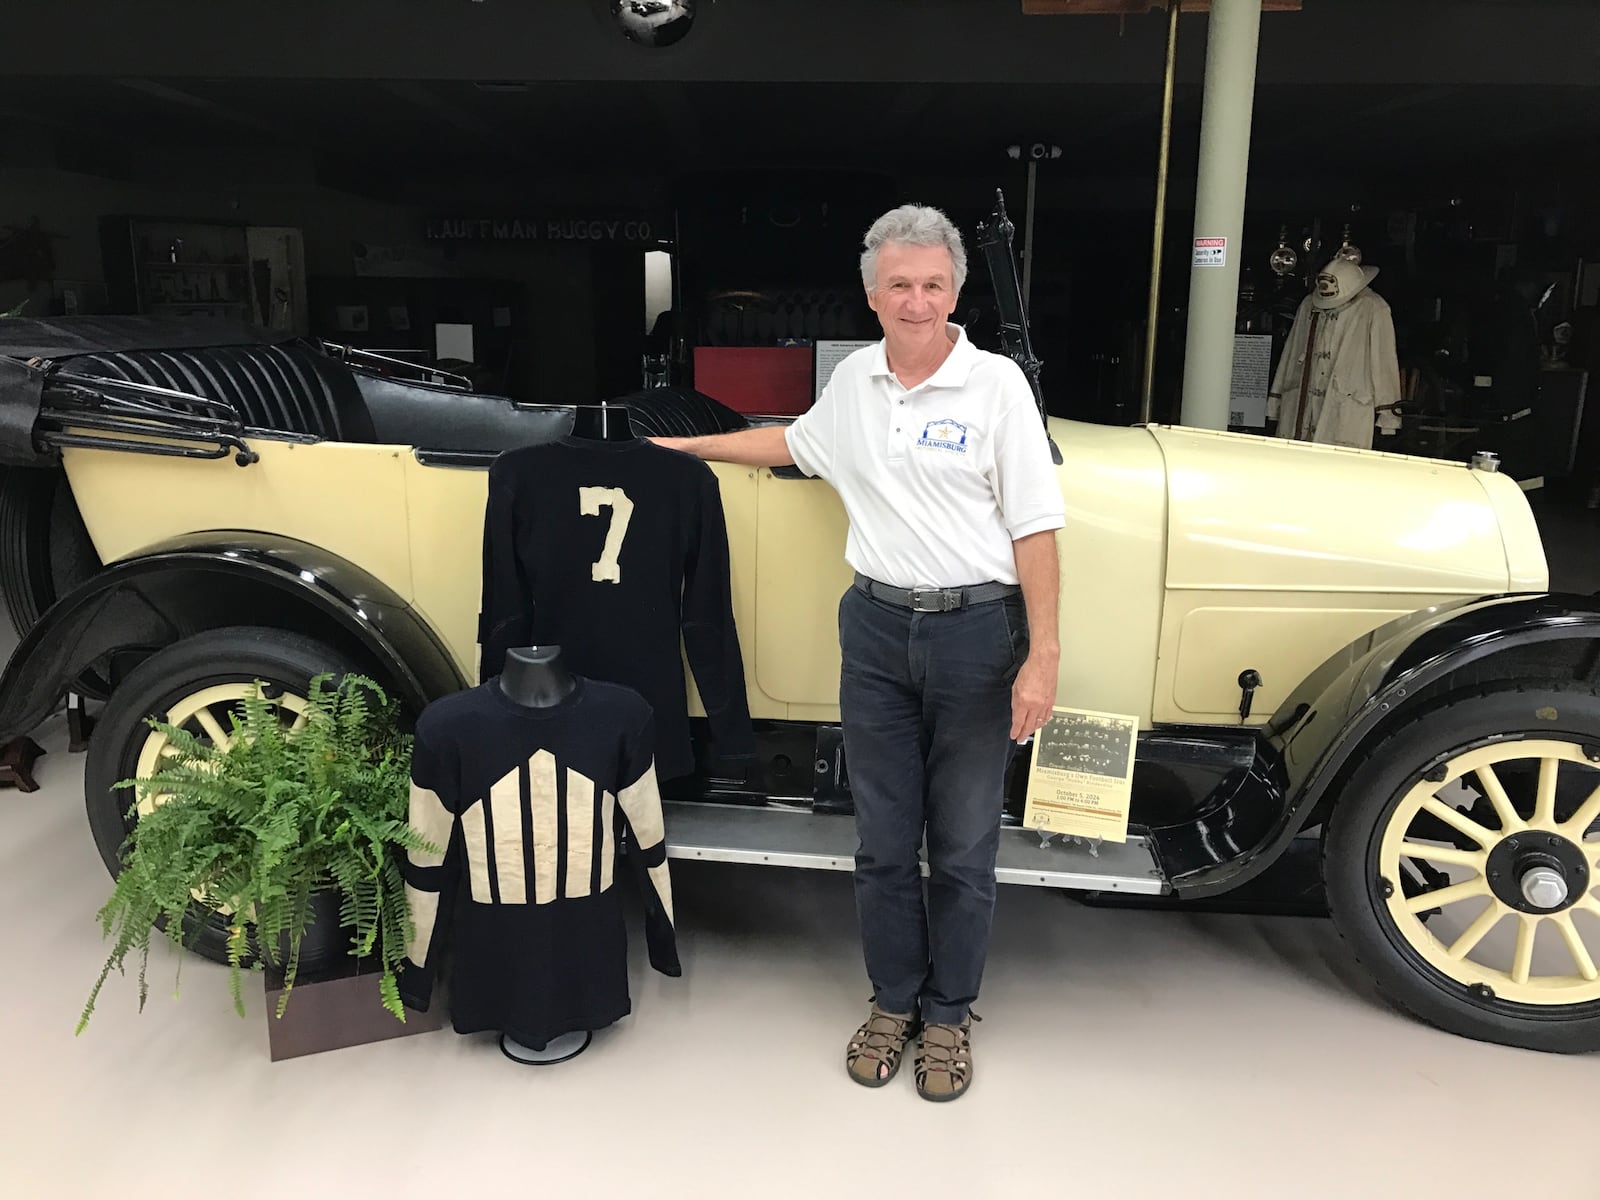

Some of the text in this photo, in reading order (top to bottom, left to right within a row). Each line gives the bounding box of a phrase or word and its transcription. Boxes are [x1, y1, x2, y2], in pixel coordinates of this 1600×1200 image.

[547, 220, 620, 240] BUGGY
[1196, 239, 1224, 247] WARNING
[916, 439, 967, 453] MIAMISBURG
[578, 486, 635, 585] 7
[1056, 789, 1078, 798] October
[1085, 793, 1100, 801] 2024
